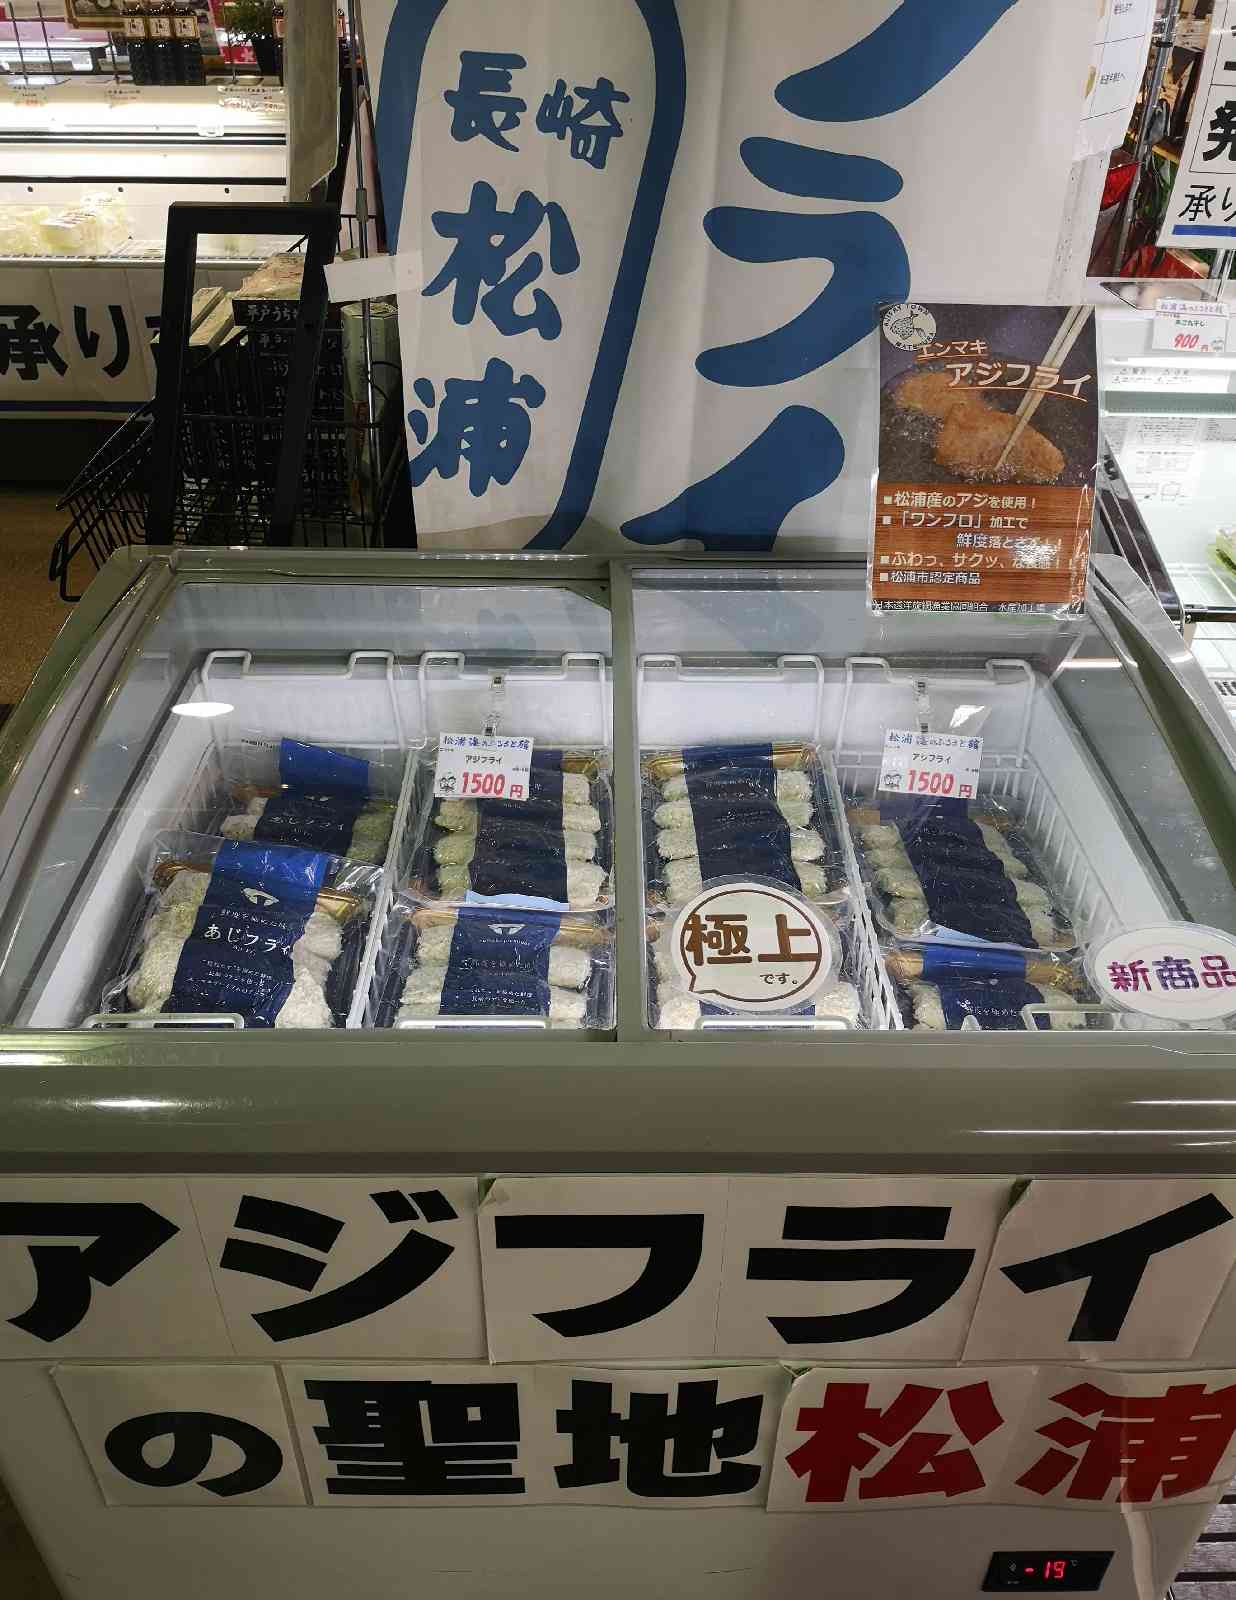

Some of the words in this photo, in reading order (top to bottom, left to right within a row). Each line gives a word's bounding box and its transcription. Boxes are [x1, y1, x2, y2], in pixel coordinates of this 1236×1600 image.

[443, 50, 630, 169] 長崎
[0, 304, 161, 380] 承り
[407, 181, 580, 497] 松浦
[920, 340, 988, 356] エンマキ
[1174, 333, 1199, 349] 900
[946, 362, 1092, 397] アジフライ
[890, 571, 981, 585] 松浦市認定商品
[465, 754, 503, 765] アジフライ
[912, 752, 952, 764] アジフライ
[462, 771, 506, 795] 1500
[509, 784, 523, 799] 円
[907, 769, 954, 794] 1500
[959, 784, 973, 798] 円
[203, 923, 291, 955] あじフライ
[685, 912, 821, 966] 極上
[759, 973, 798, 985] です。
[1108, 954, 1236, 993] 新商品
[0, 1189, 1235, 1344] アジフライ
[104, 1379, 1236, 1503] の聖地松浦
[1023, 1560, 1067, 1580] -19
